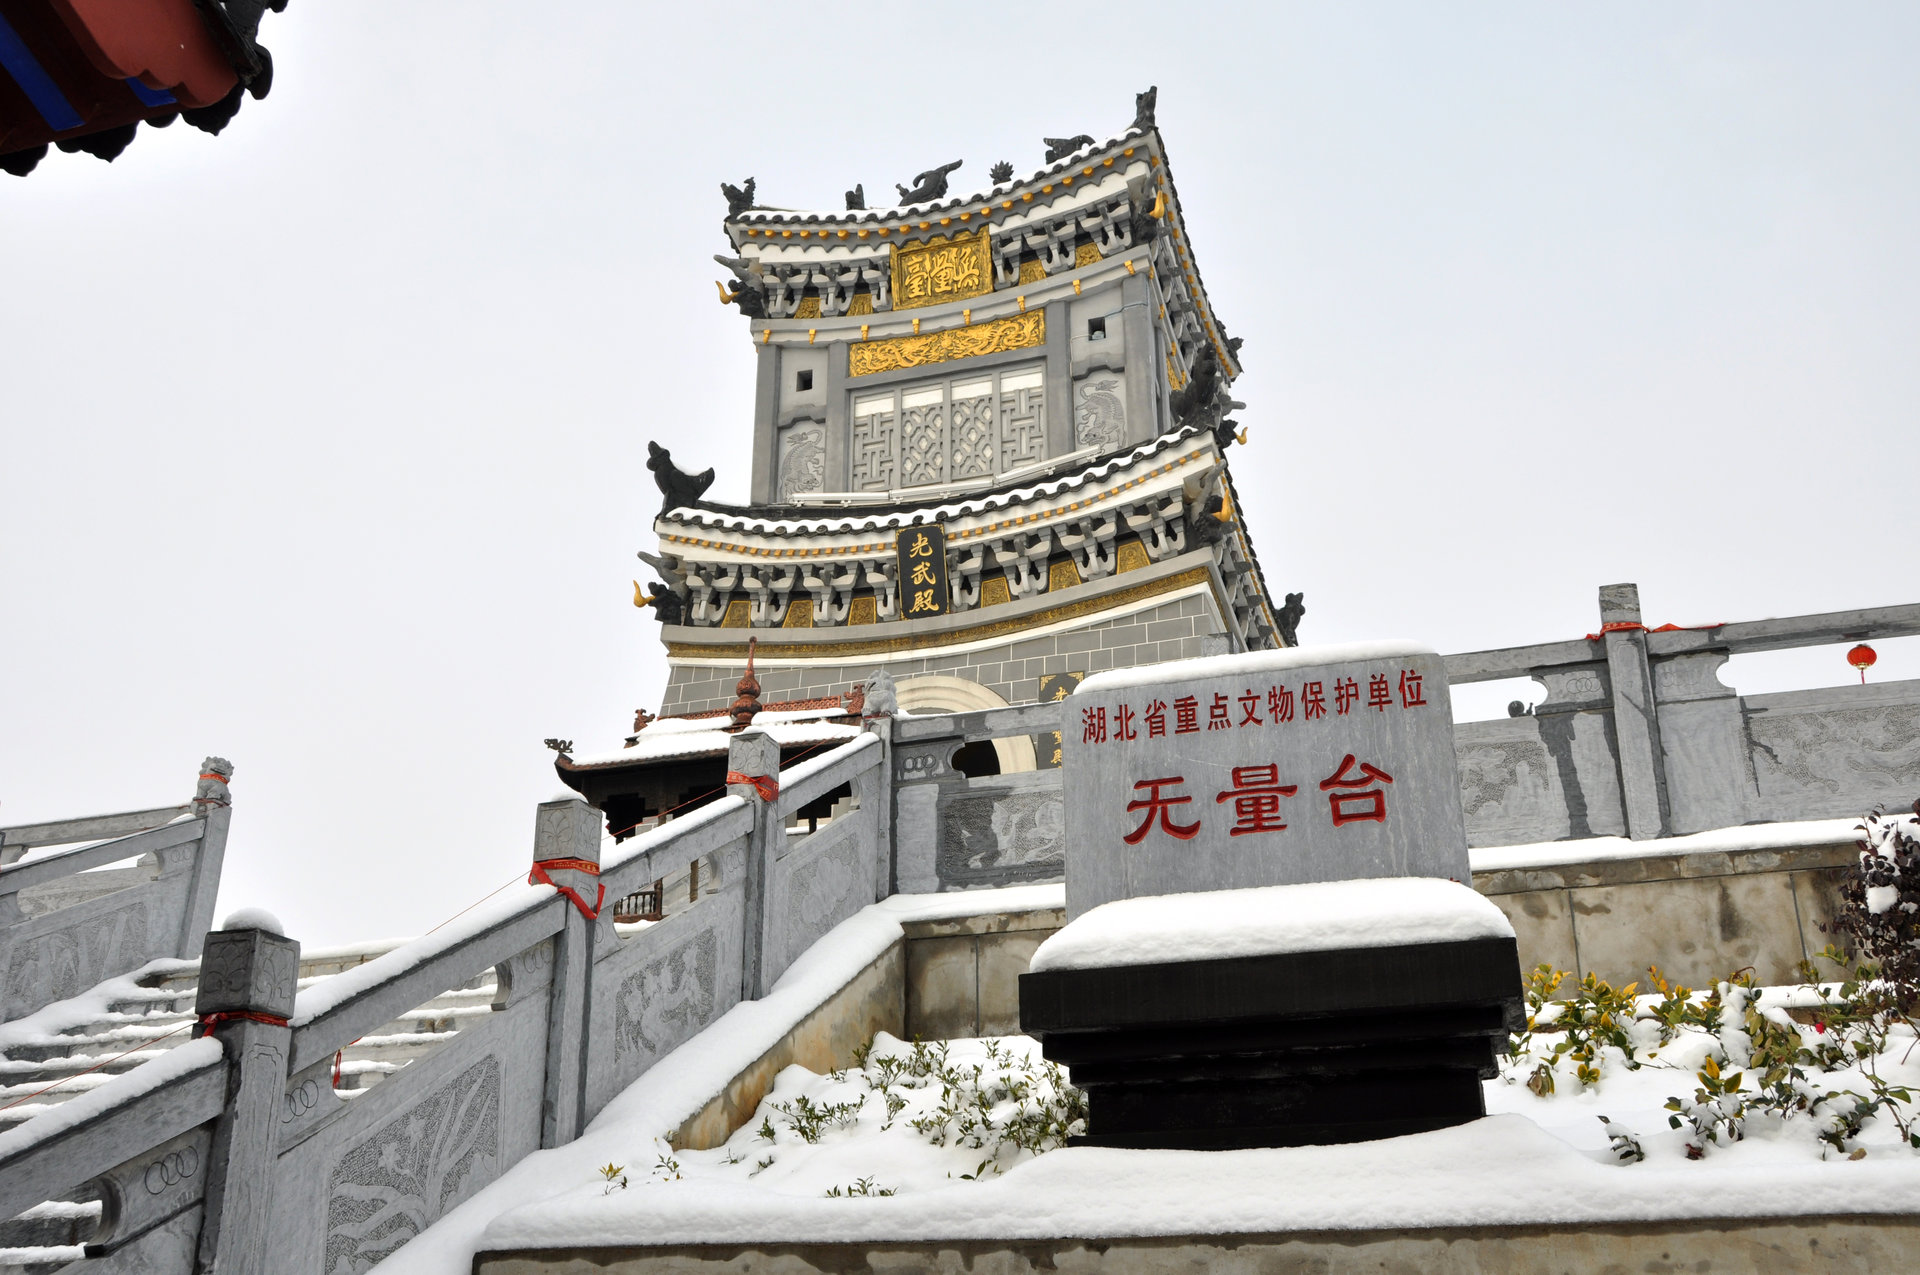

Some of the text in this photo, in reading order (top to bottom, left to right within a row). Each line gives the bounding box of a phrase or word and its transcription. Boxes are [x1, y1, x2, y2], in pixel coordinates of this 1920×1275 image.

[909, 532, 940, 613] 光武殿
[1082, 669, 1428, 745] 湖北省重点文物保护单位
[1123, 753, 1394, 845] 无量台
